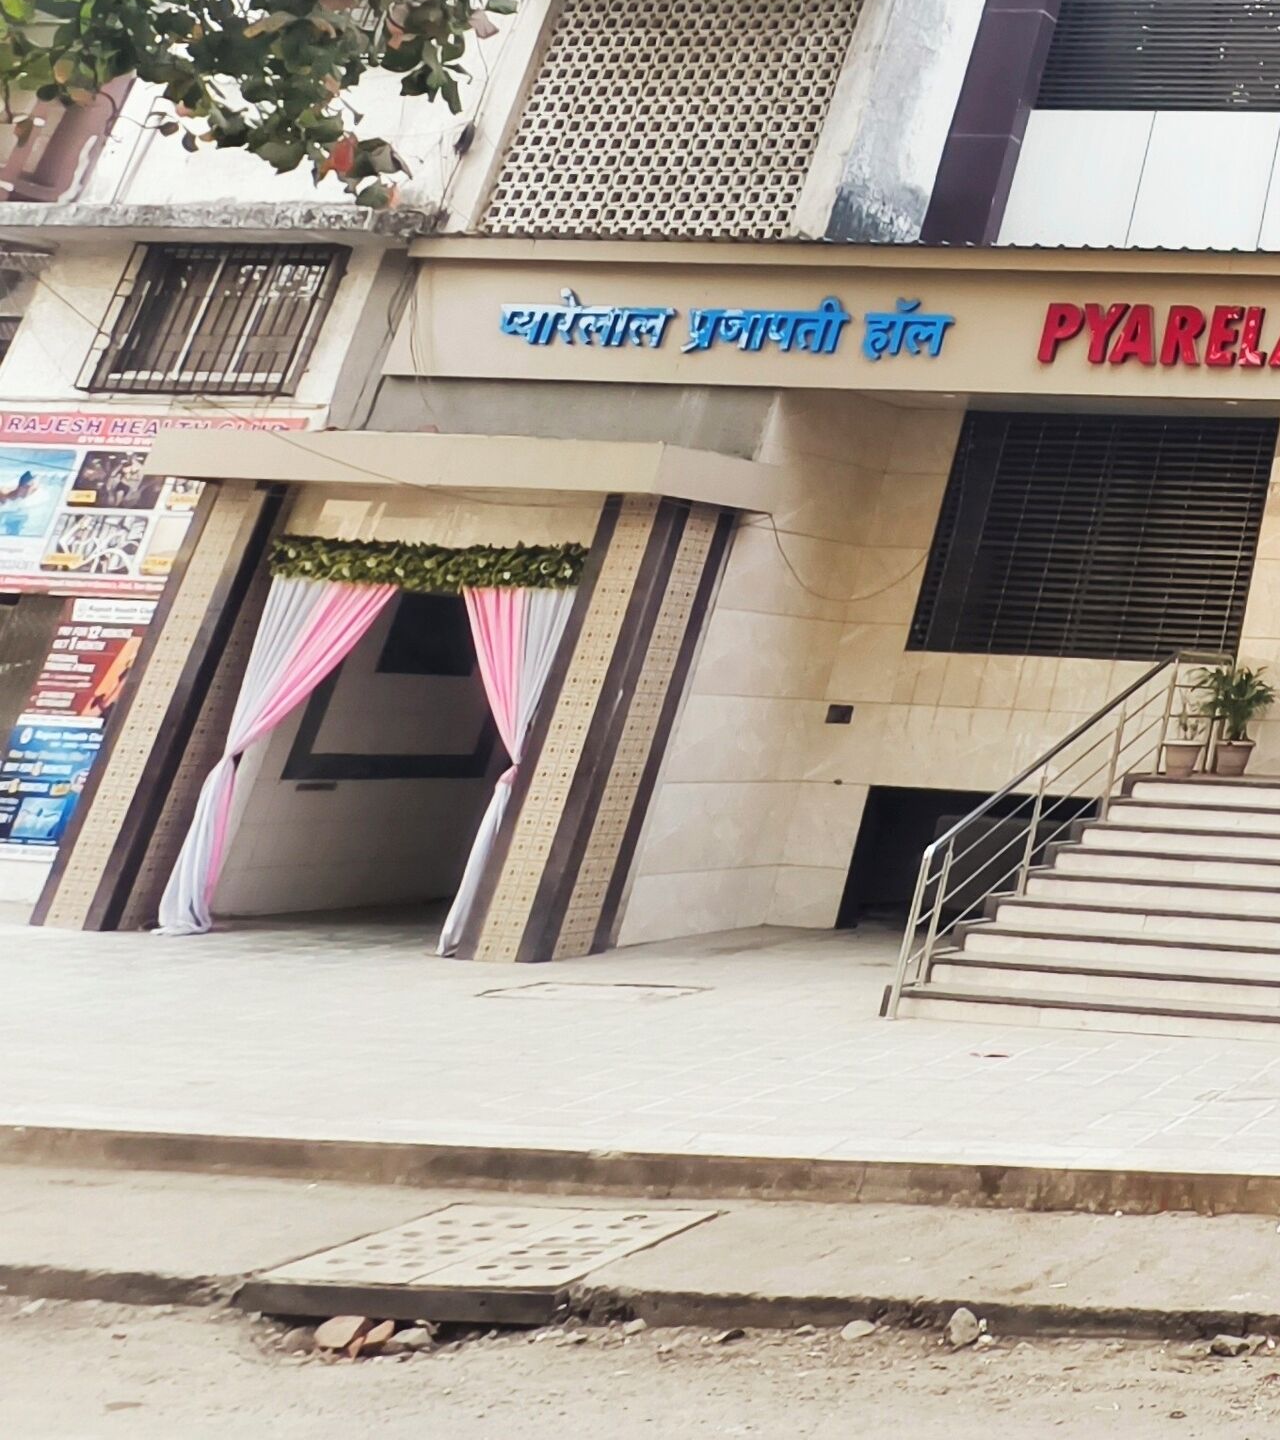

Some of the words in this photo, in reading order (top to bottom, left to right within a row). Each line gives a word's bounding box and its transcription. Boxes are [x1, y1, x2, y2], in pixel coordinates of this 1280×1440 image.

[500, 288, 676, 348] प्यारेलाल
[681, 296, 850, 355] प्रजापती
[863, 299, 954, 359] हॉल
[7, 416, 104, 433] RAJESH
